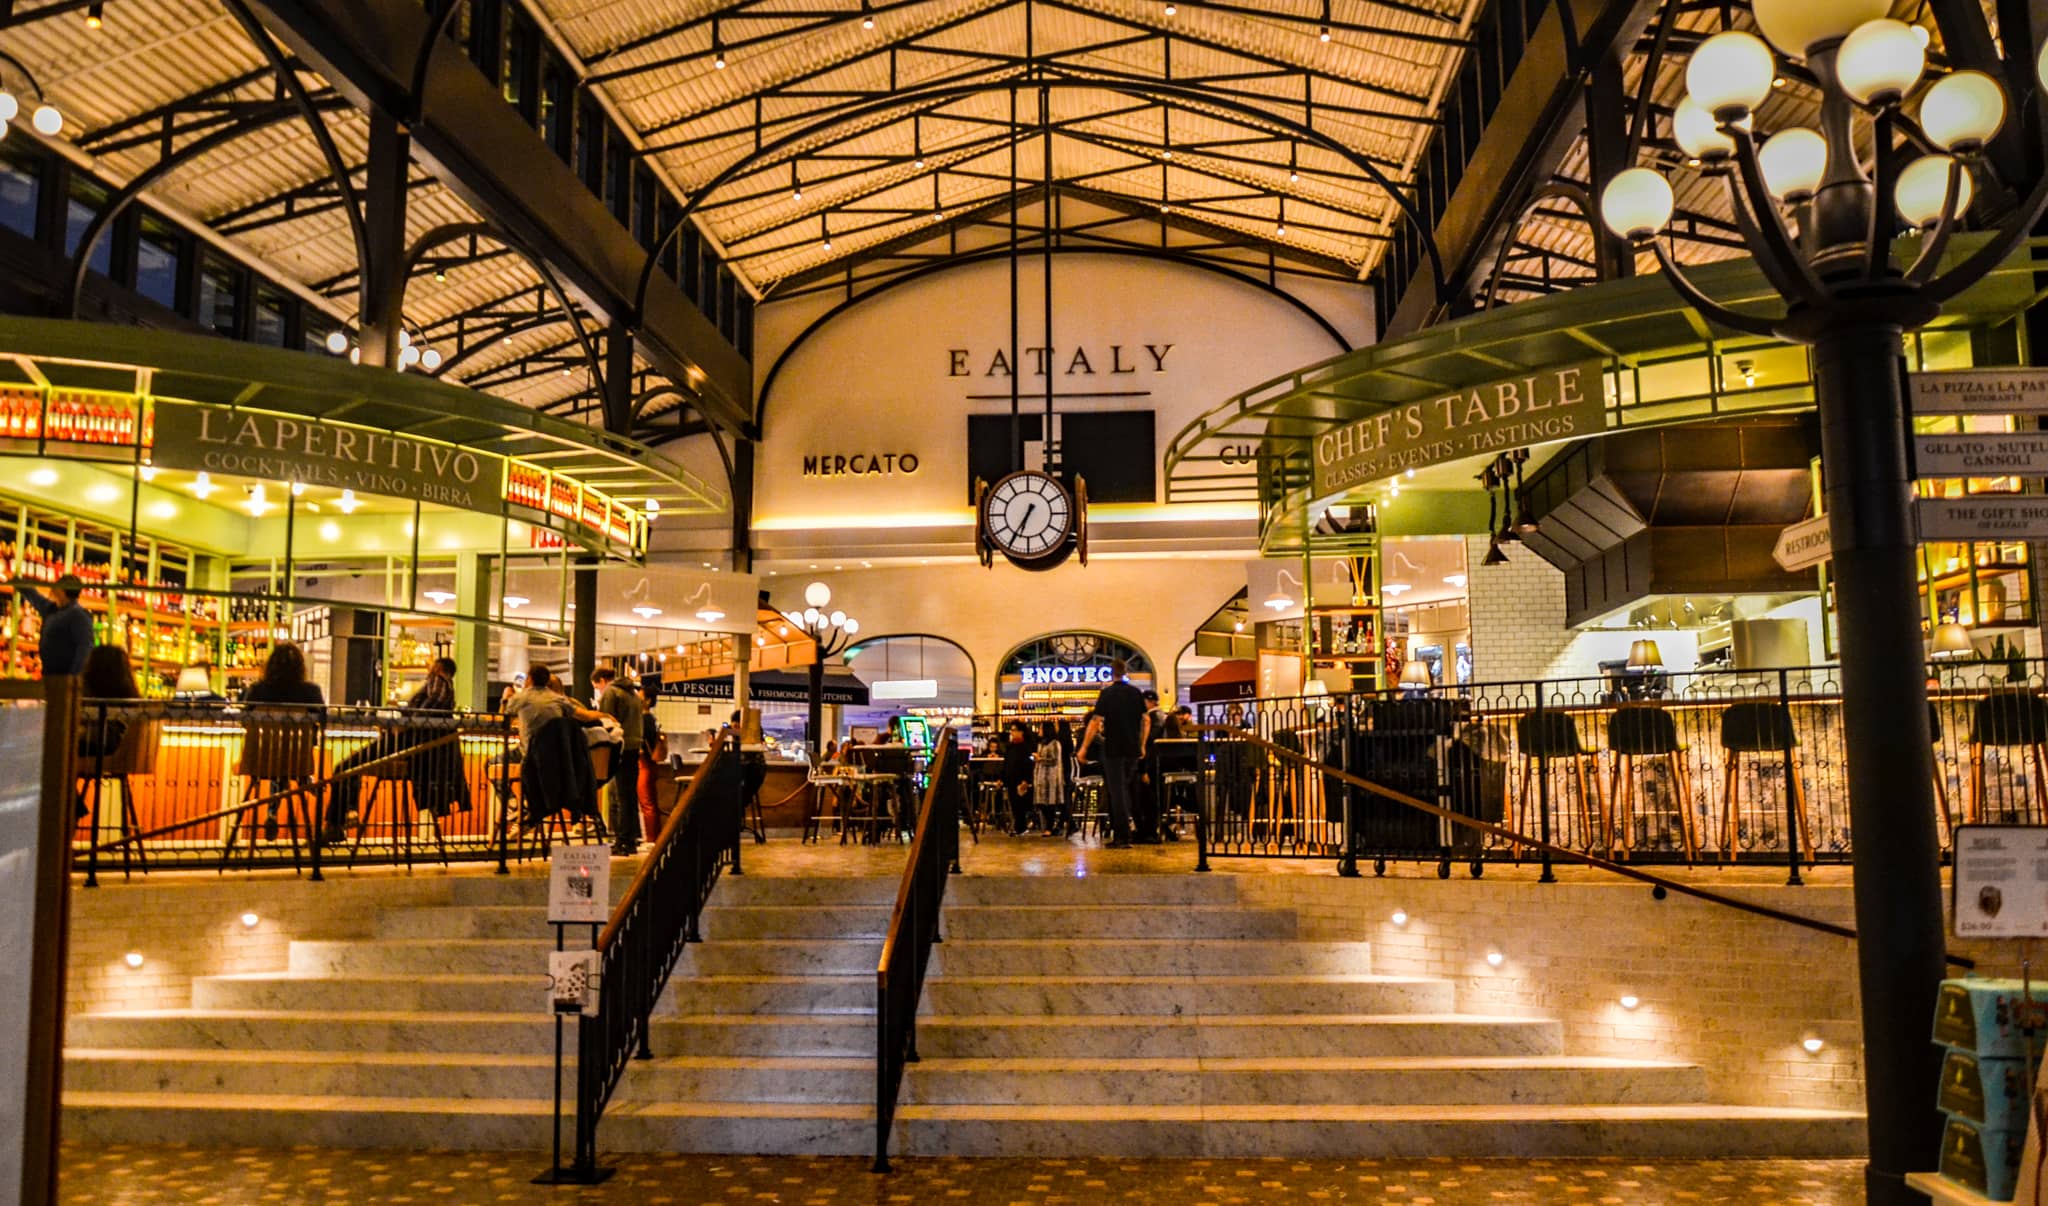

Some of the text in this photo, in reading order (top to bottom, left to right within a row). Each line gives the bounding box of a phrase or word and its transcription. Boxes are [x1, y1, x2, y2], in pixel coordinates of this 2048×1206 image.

[948, 344, 1175, 377] EATALY
[1921, 382, 1940, 393] LA
[1944, 381, 1985, 393] PIZZA
[1997, 381, 2016, 392] LA
[1319, 367, 1585, 466] CHEF'S TABLE
[199, 408, 480, 484] L'APERITIVO
[1219, 444, 1261, 465] CU
[1325, 414, 1576, 489] CLASSES EVENTS TASTINGS
[1926, 442, 1985, 455] GELATO
[802, 453, 920, 477] MERCATO
[1963, 453, 2031, 467] CANNOLI
[204, 452, 473, 506] COCKTAILS VINO BIRRA
[1946, 507, 1975, 519] THE
[1982, 506, 2016, 519] GIFT
[1020, 666, 1130, 684] ENOTEC
[661, 682, 679, 694] LA
[820, 692, 853, 702] ITCHEN
[1239, 684, 1254, 695] LA
